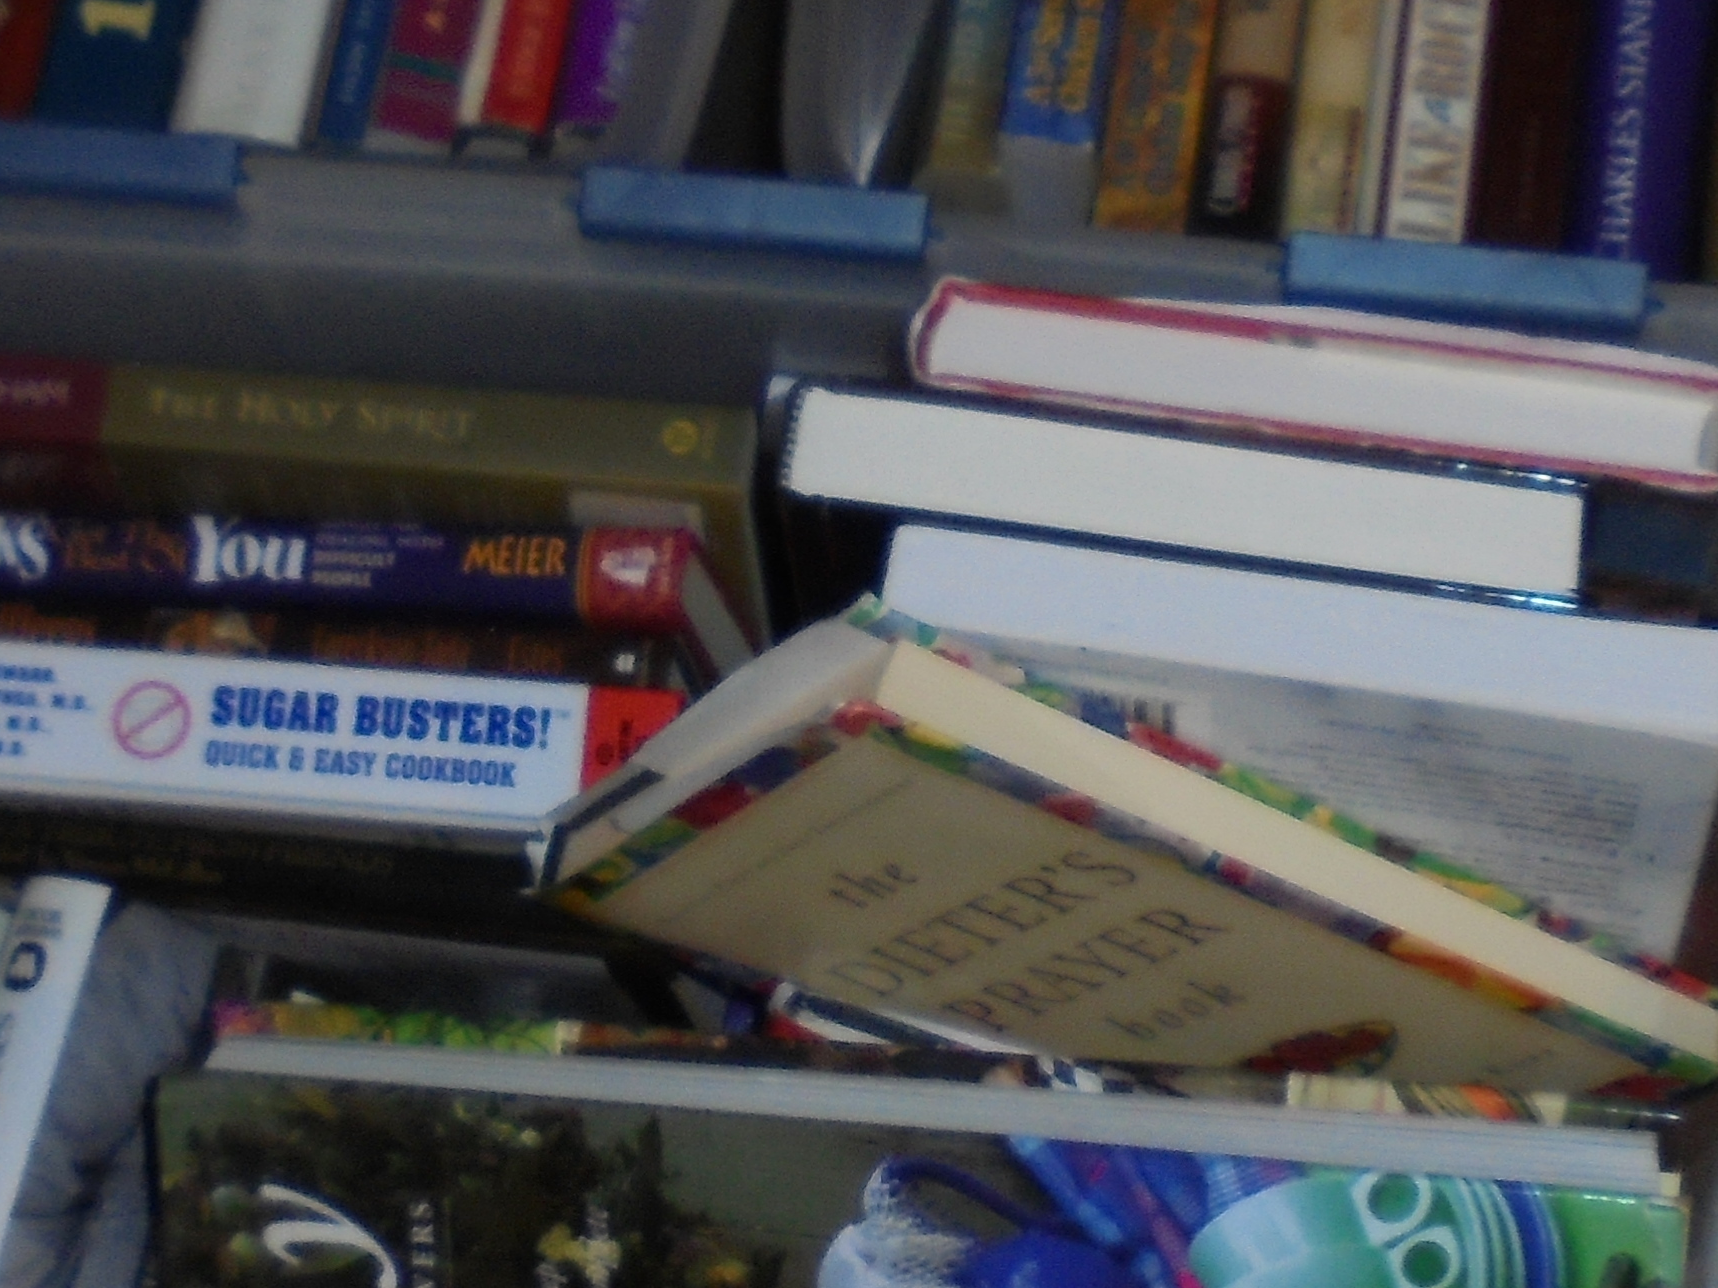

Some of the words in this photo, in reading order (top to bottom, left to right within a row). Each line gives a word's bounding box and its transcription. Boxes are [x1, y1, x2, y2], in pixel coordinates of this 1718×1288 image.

[1395, 126, 1465, 241] LIKE
[235, 387, 343, 431] HOLY
[360, 400, 475, 441] SPIRIT
[188, 514, 308, 587] You
[461, 535, 568, 579] MEIER
[210, 682, 342, 737] SUGAR
[355, 692, 552, 751] BUSTERS!
[204, 739, 282, 771] QUICK
[314, 746, 378, 778] EASY
[384, 749, 518, 789] COOKBOOK
[826, 857, 924, 909] the
[828, 848, 1142, 1000] DIETER'S
[938, 907, 1235, 1035] PRAYER
[1106, 978, 1242, 1045] book
